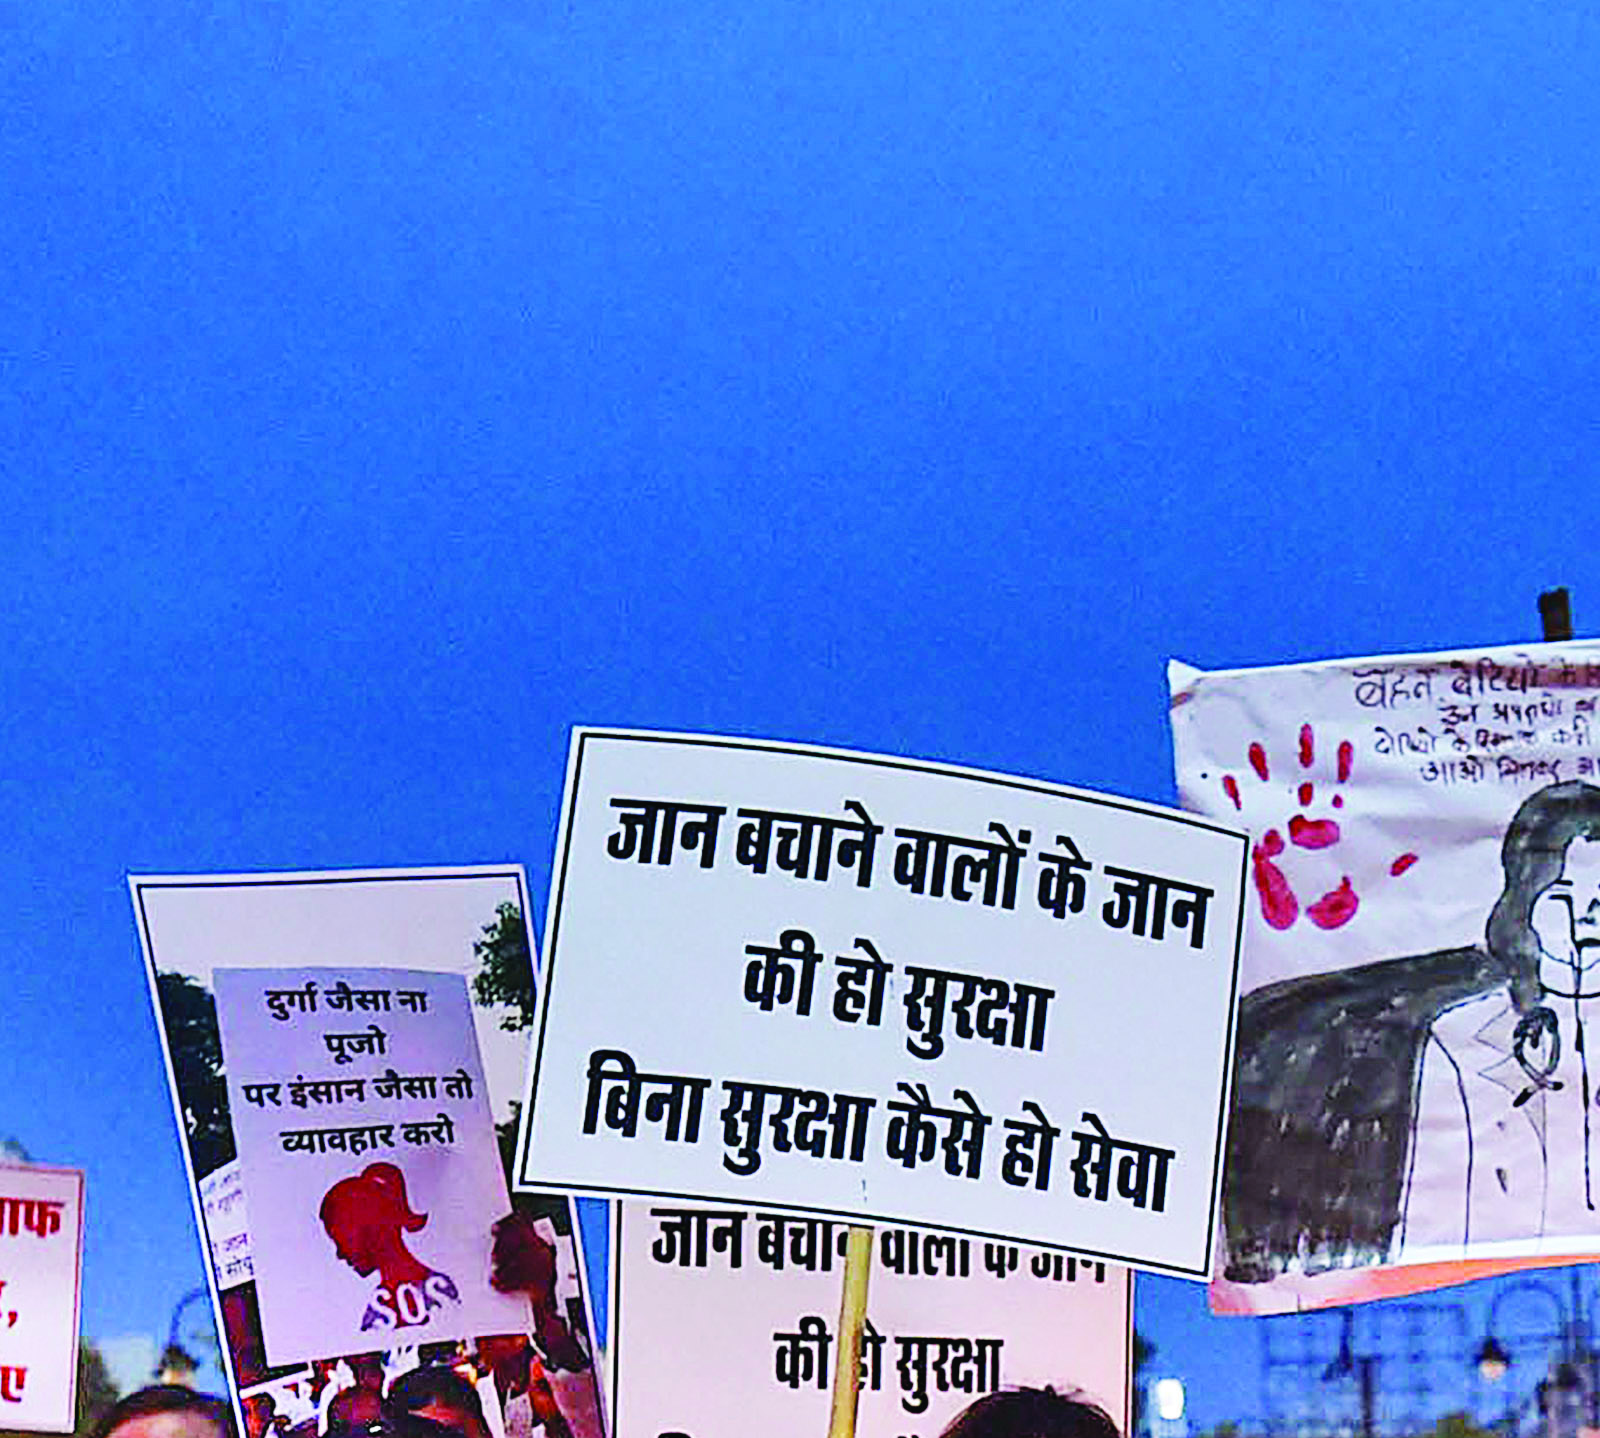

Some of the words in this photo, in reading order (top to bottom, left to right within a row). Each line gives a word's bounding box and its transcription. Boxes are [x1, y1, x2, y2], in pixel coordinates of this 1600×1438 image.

[607, 798, 727, 869] जान
[736, 800, 883, 888] बचाने
[893, 822, 1031, 911] वालों
[1037, 836, 1093, 920] के
[1103, 866, 1214, 949] जान
[265, 982, 317, 1021] दुर्गा
[324, 982, 390, 1012] जैसा
[397, 991, 427, 1013] ना
[744, 929, 822, 1016] की
[833, 938, 893, 1026] हो
[903, 965, 1055, 1060] सुरक्षा
[323, 1025, 386, 1064] पूजो
[242, 1084, 281, 1107] पर
[287, 1074, 366, 1108] इंसान
[372, 1069, 436, 1100] जैसा
[443, 1069, 473, 1099] तो
[280, 1125, 395, 1156] व्यावहार
[401, 1113, 455, 1145] करो
[581, 1049, 711, 1143] बिना
[721, 1080, 876, 1176] सुरक्षा
[887, 1081, 992, 1180] कैसे
[1001, 1102, 1061, 1193] हो
[1070, 1112, 1176, 1214] सेवा
[651, 1208, 747, 1268] जान
[773, 1316, 833, 1390] की
[895, 1335, 1004, 1414] सुरक्षा
